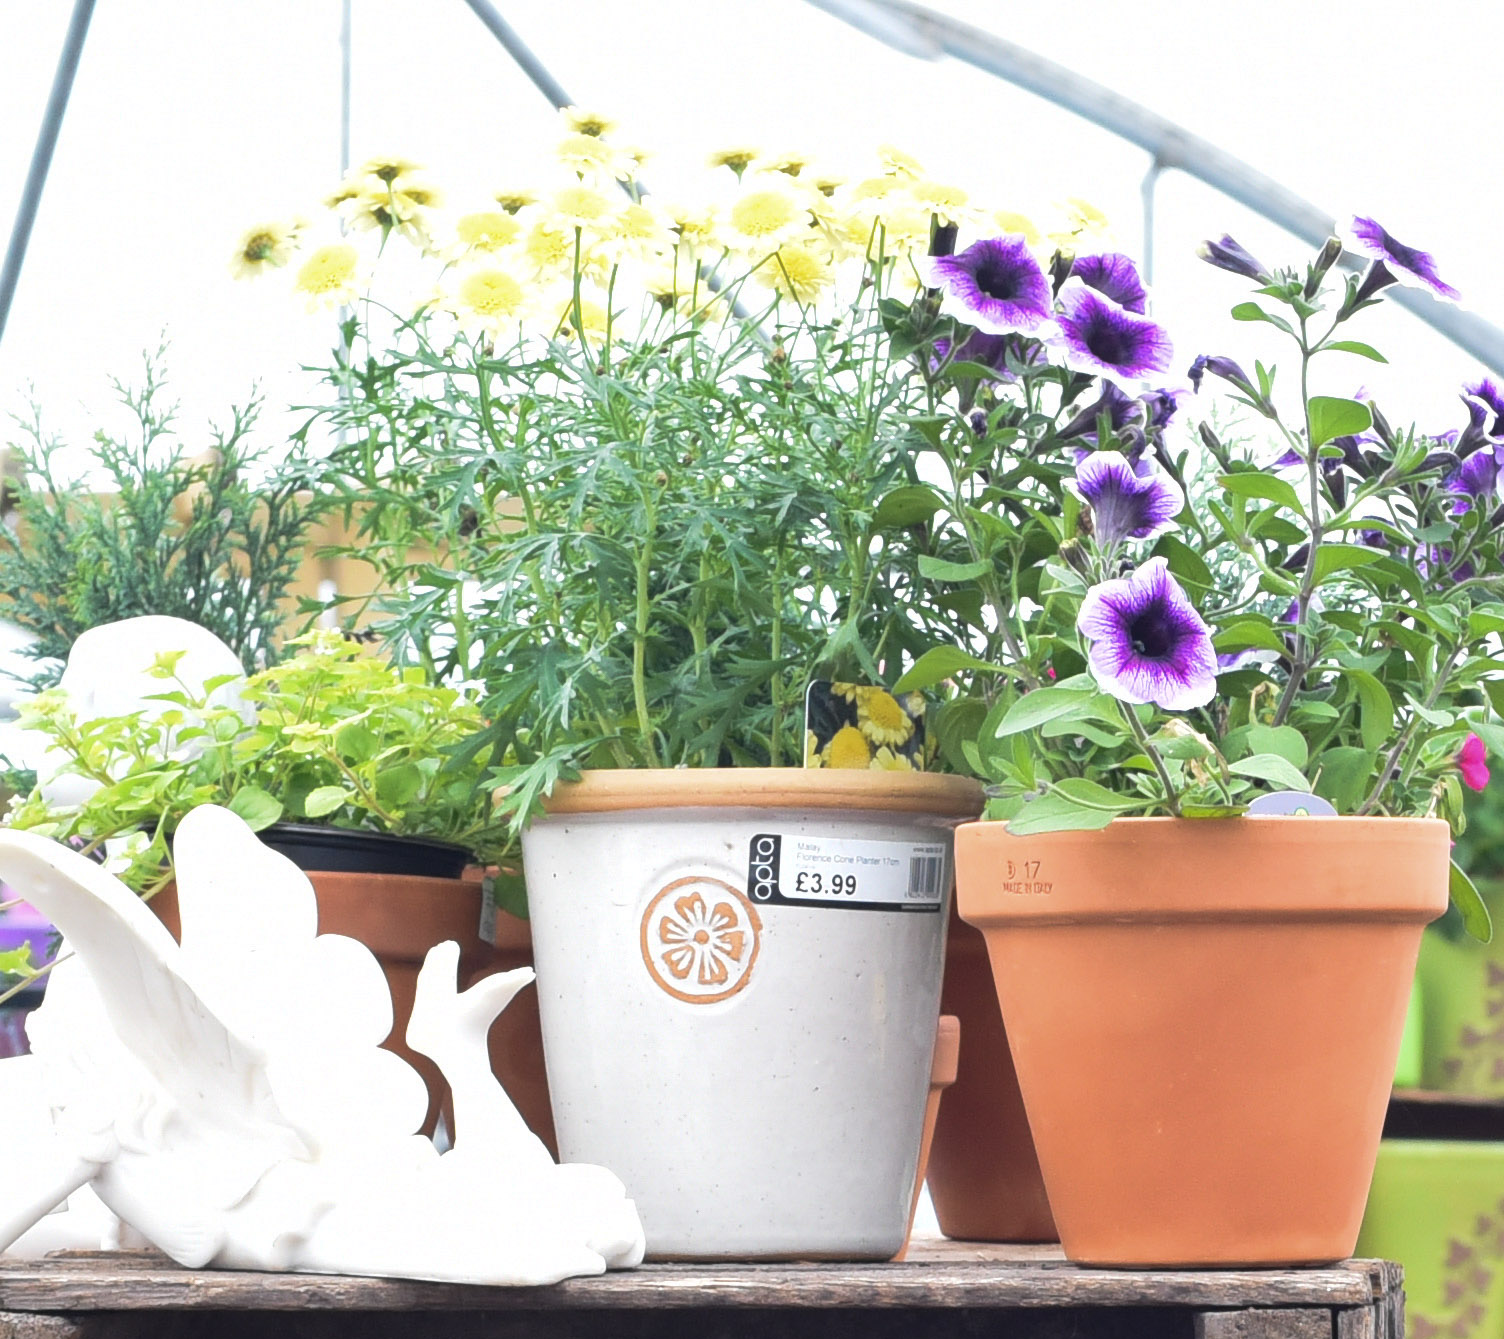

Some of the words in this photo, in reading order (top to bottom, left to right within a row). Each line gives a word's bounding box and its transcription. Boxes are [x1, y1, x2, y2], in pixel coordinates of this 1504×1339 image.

[750, 837, 778, 900] apta
[796, 852, 832, 863] Florence
[1024, 860, 1041, 879] 17
[795, 871, 857, 896] £3.99
